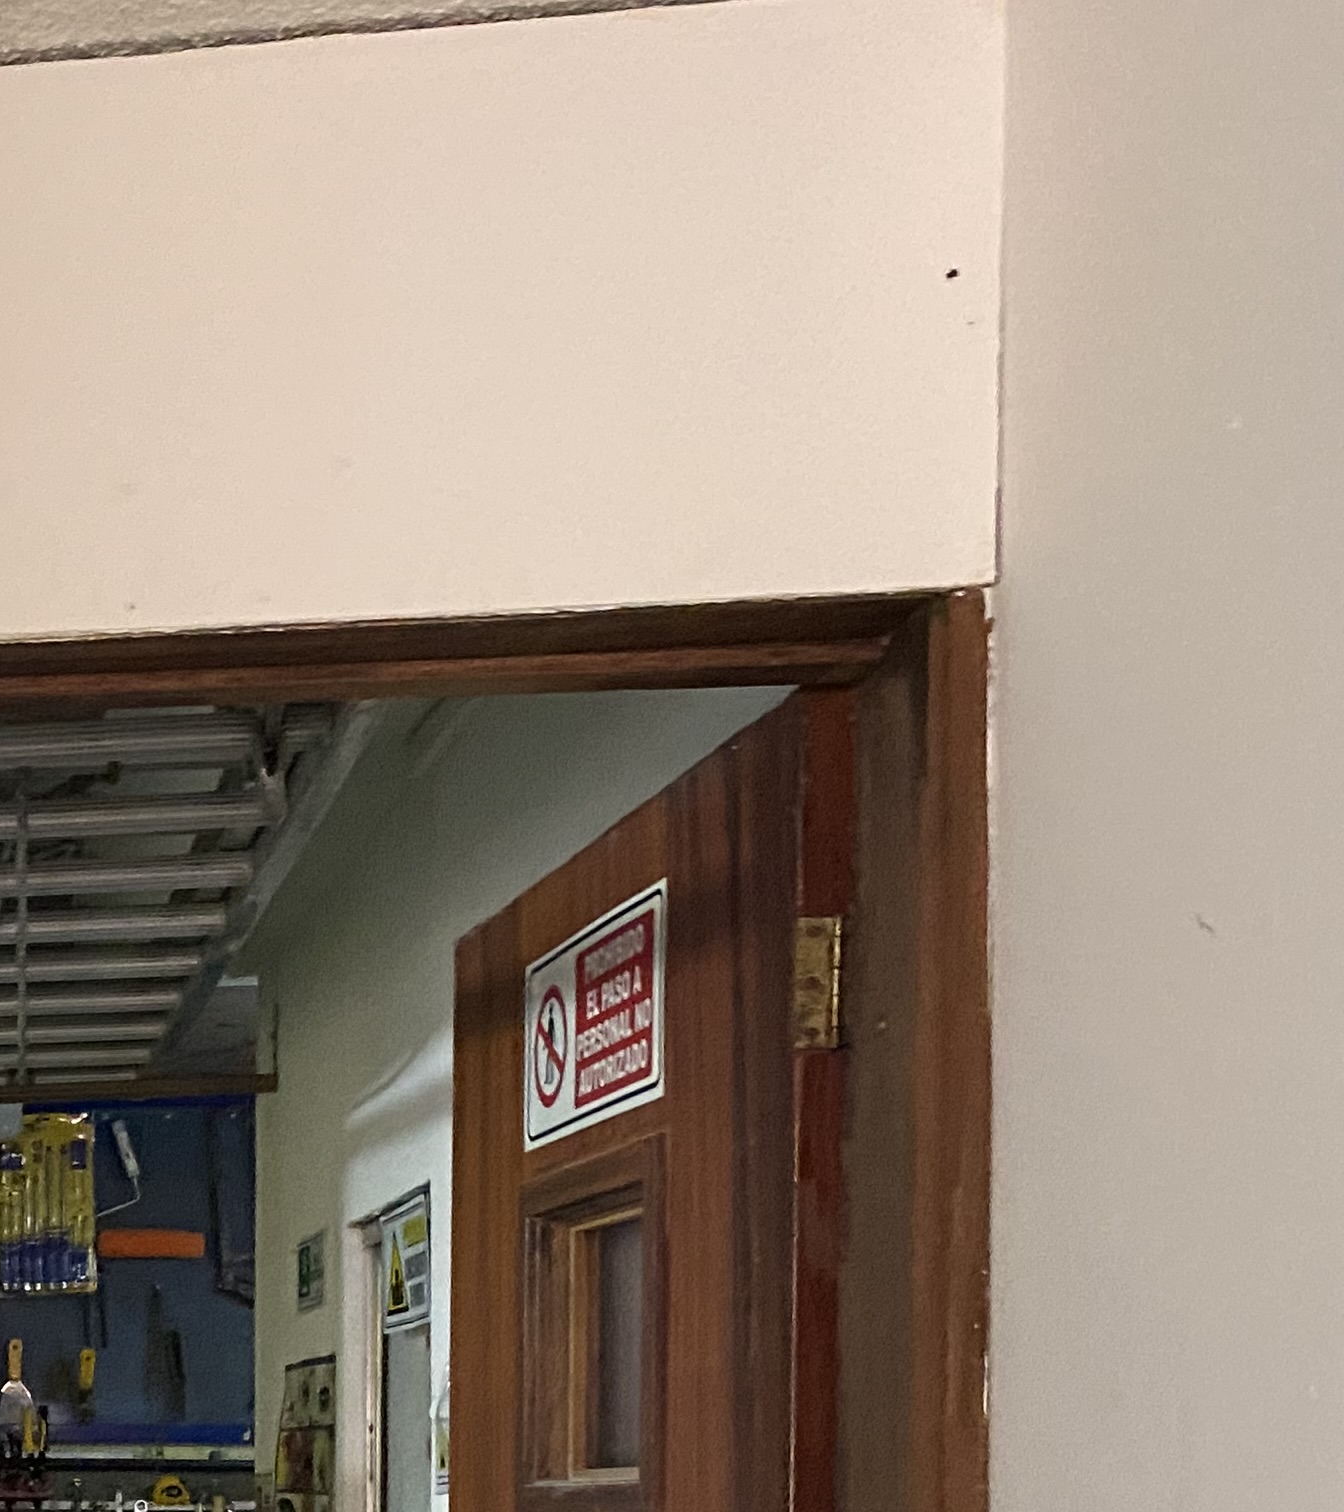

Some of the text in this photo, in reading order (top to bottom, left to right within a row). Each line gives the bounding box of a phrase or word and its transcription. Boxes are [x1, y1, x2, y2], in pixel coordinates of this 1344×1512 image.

[584, 923, 644, 985] PROHIBIDO
[586, 964, 643, 1020] EL PASO A
[576, 997, 651, 1061] PERSONAL NO
[577, 1038, 648, 1097] AUTORIZADO
